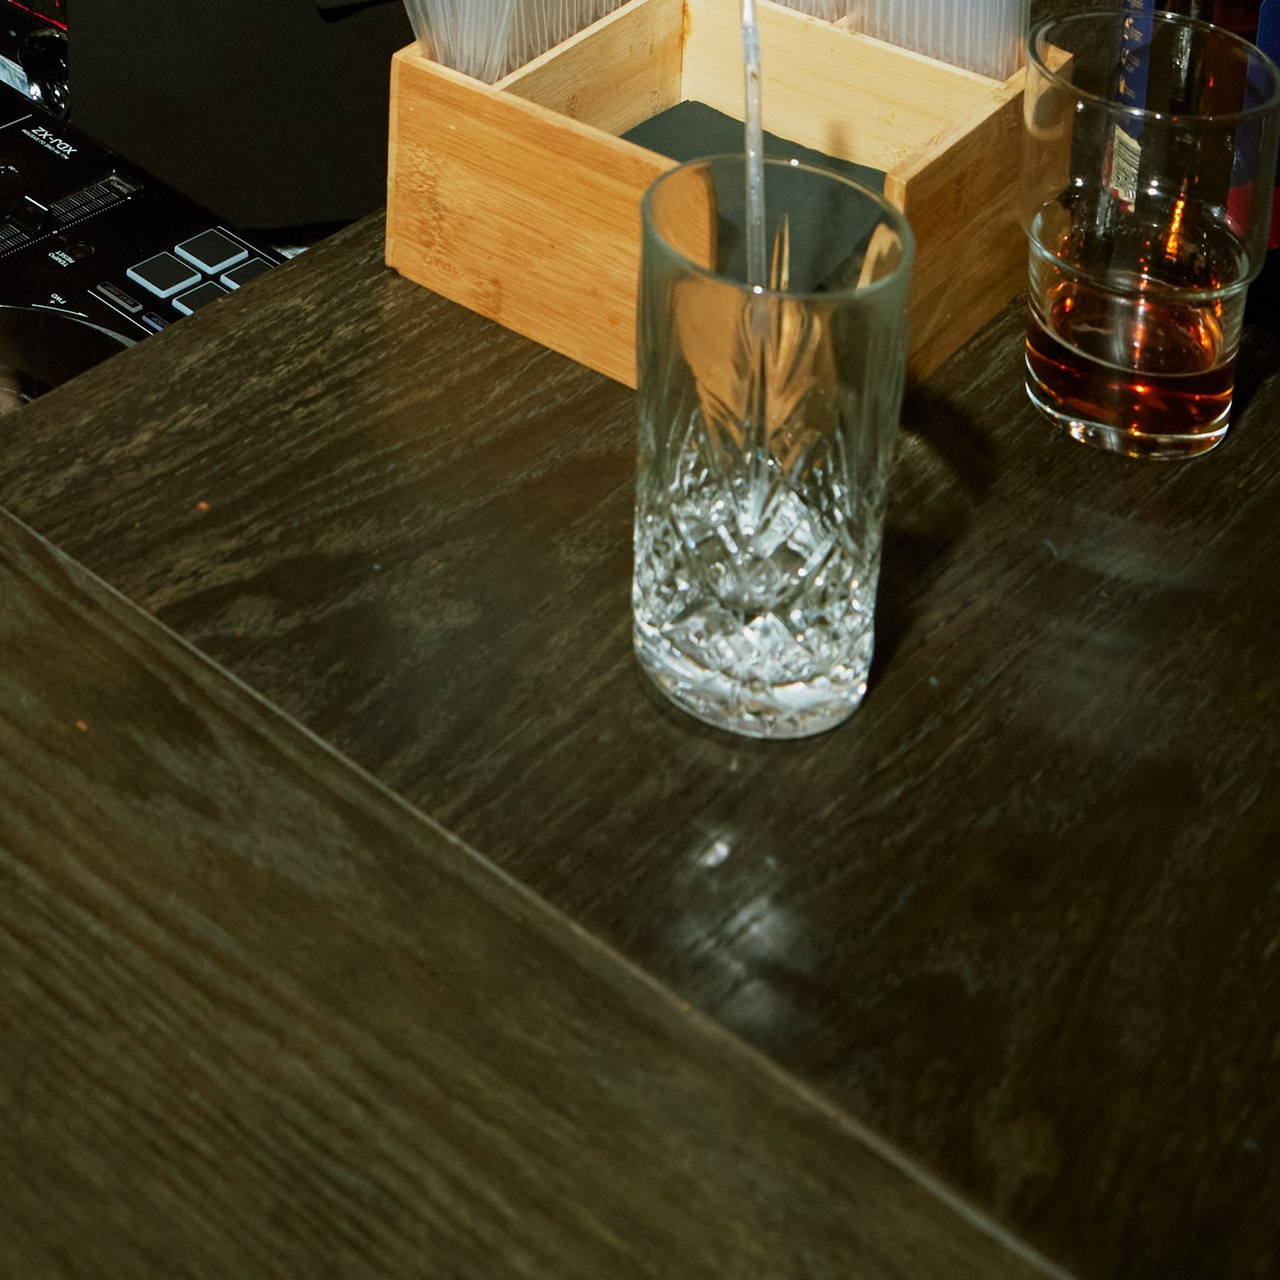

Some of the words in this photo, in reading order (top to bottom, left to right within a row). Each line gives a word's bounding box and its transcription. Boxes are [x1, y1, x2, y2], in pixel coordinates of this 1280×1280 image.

[31, 126, 77, 155] XDJ-XZ
[48, 252, 69, 267] TEMPO
[55, 250, 75, 263] RESET
